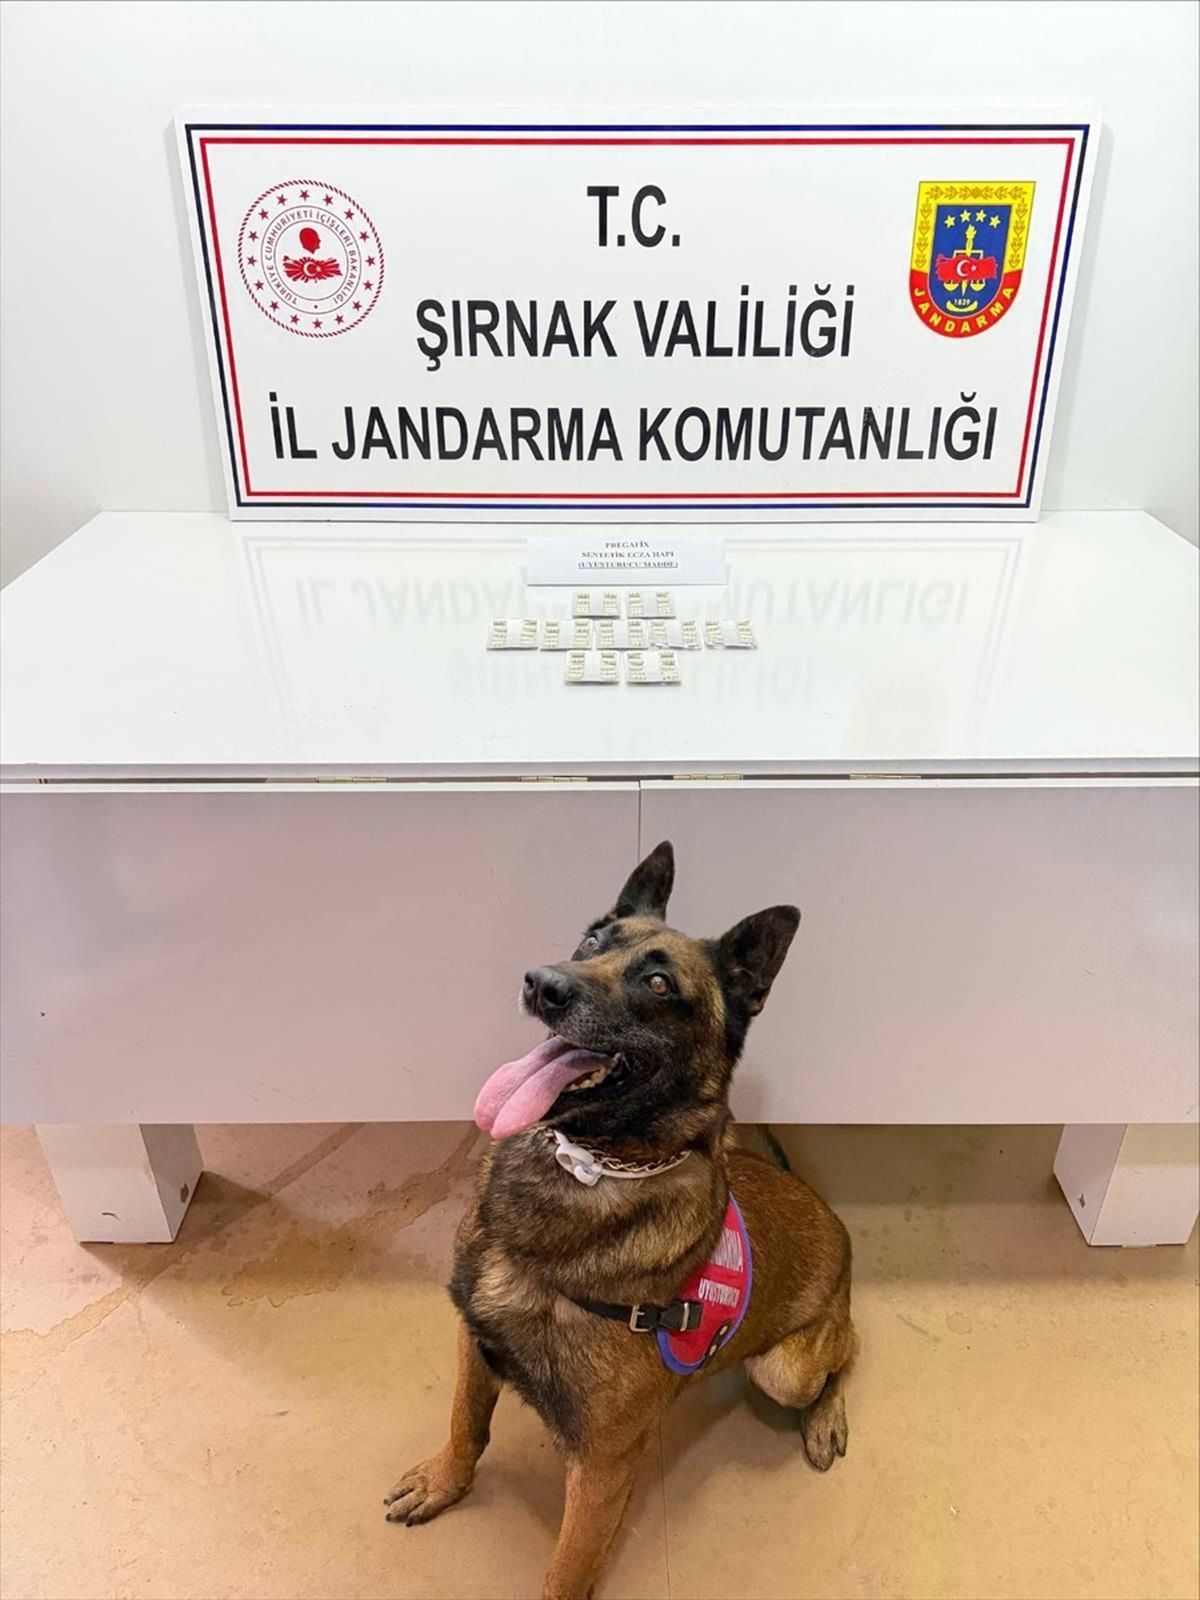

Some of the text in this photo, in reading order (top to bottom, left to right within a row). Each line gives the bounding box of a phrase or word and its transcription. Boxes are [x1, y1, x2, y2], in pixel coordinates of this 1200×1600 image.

[586, 184, 681, 248] T.C.
[265, 209, 358, 304] TÜRKİYE CUMHURİYETİ İÇİŞLERİ BAKANLIĞI
[416, 283, 855, 372] ŞIRNAK VALİLİĞİ
[914, 287, 1014, 333] JANDARMA
[269, 391, 998, 462] İL JANDARMA KOMUTANLIĞI
